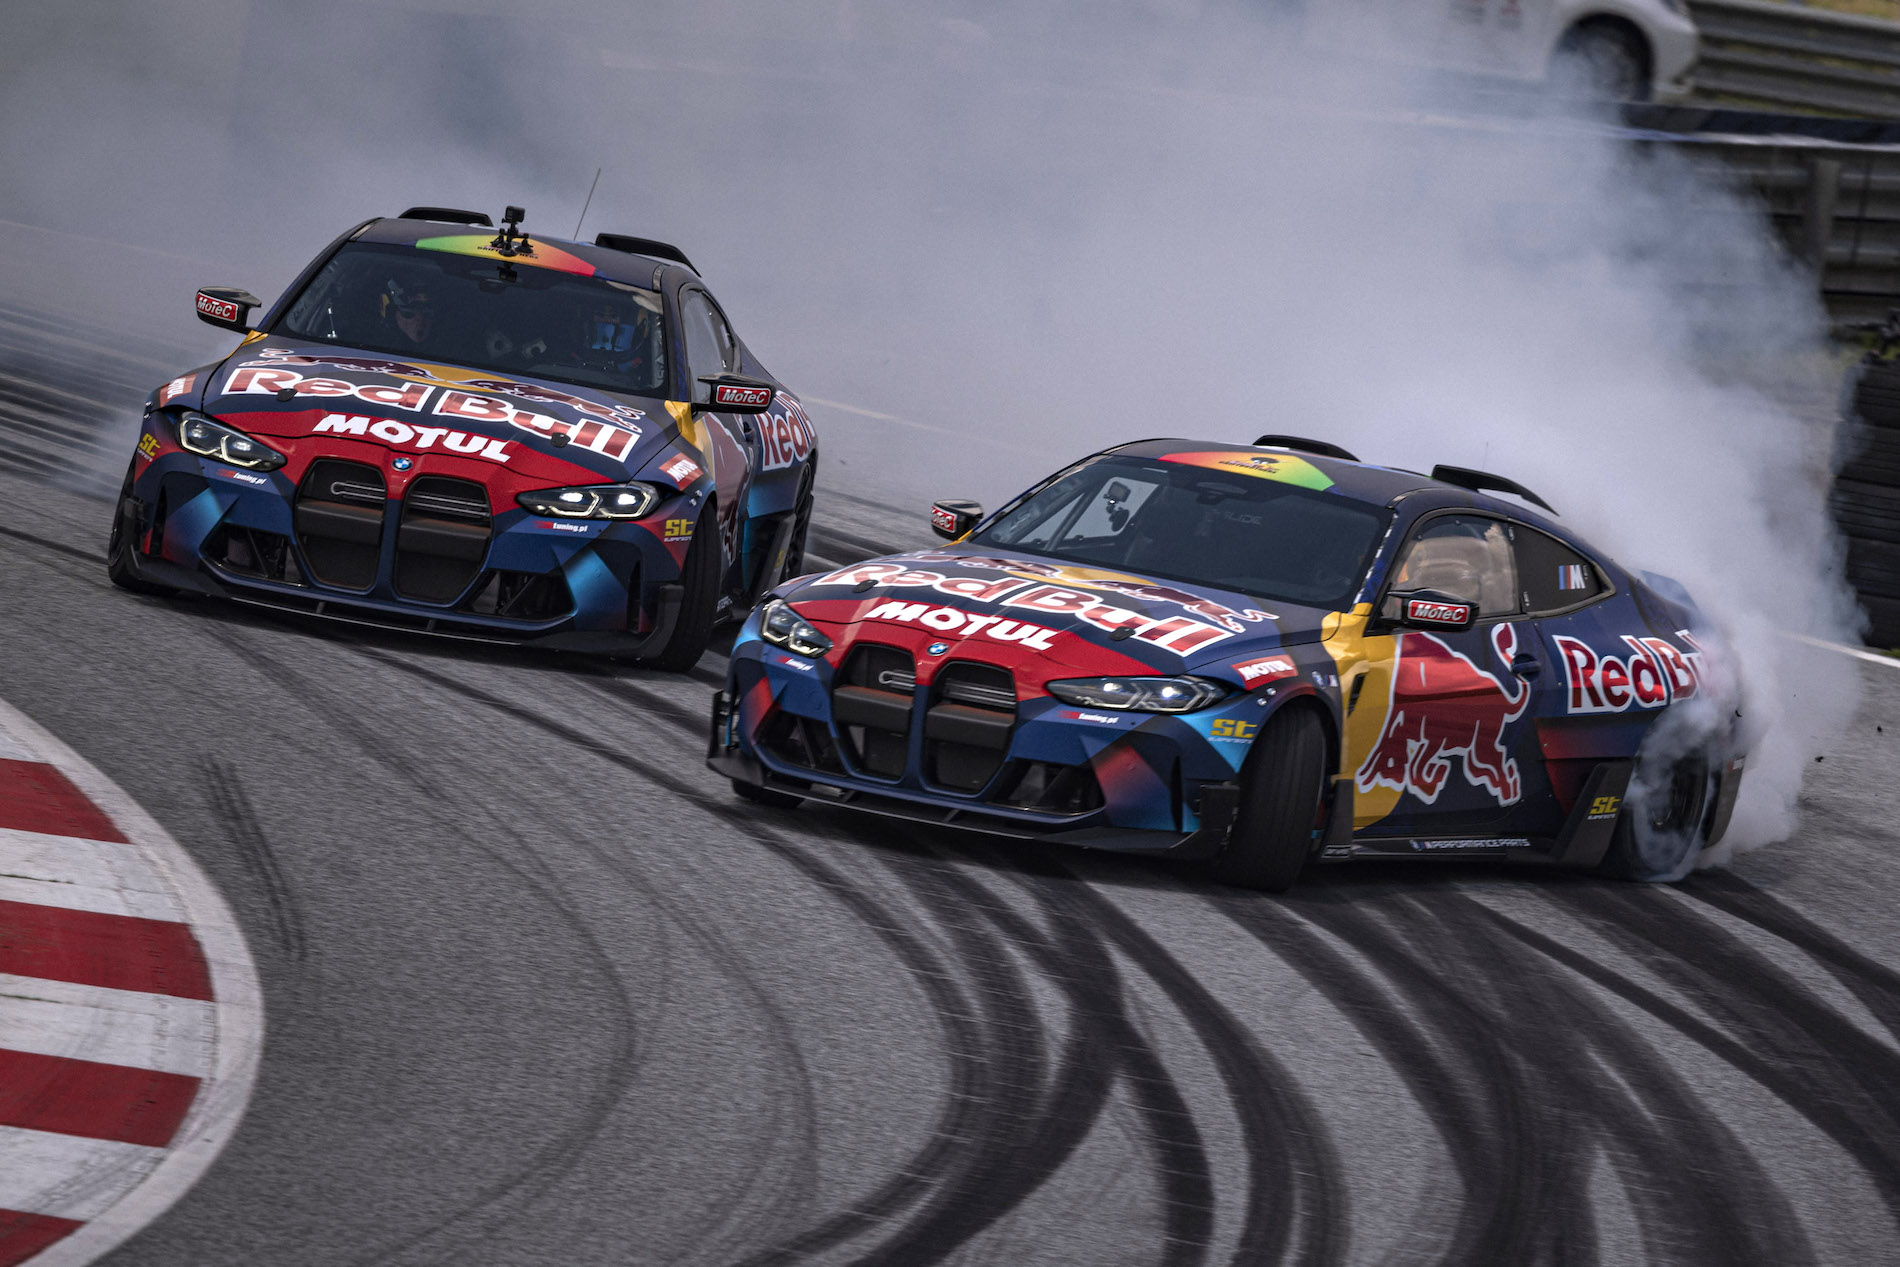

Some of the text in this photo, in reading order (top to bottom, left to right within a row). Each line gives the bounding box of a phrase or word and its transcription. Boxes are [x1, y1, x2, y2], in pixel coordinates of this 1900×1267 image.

[197, 297, 232, 317] MoTeC
[722, 388, 767, 404] MoTeC
[221, 367, 642, 463] Red Bull
[312, 413, 511, 463] MOTUL
[811, 564, 1236, 657] Red Bull
[862, 601, 1054, 650] MOTUL
[1414, 604, 1465, 621] MoTeC
[1238, 660, 1293, 681] MOTUL
[1553, 634, 1671, 714] Red
[1431, 839, 1500, 849] PERFORMANCE
[1500, 838, 1531, 847] PARTS
